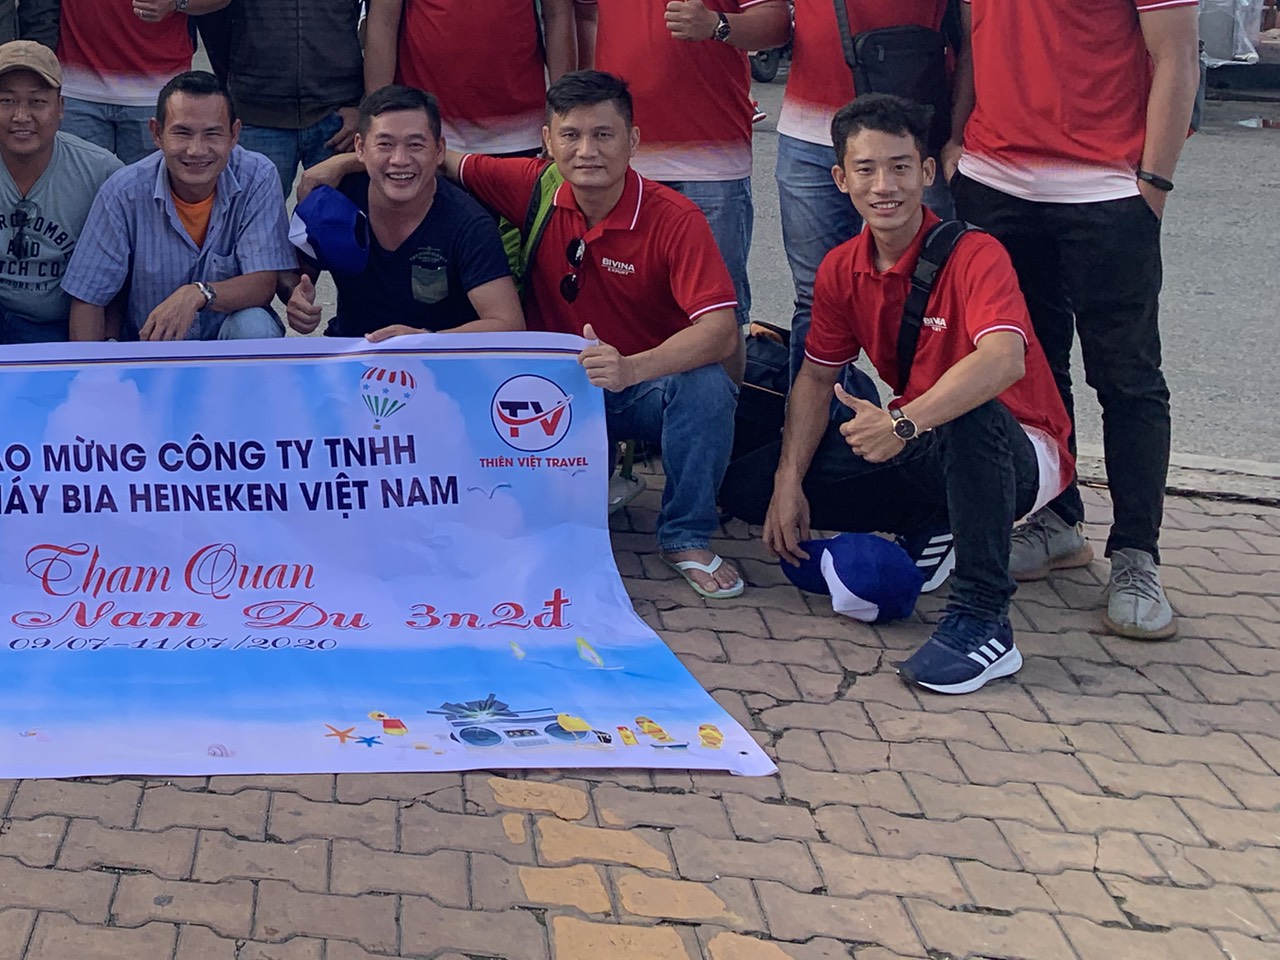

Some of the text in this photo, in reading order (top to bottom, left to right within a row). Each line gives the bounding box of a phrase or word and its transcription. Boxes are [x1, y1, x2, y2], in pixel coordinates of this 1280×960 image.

[7, 239, 40, 257] AND
[602, 257, 635, 271] BIVINA
[43, 435, 147, 472] MỪNG
[158, 433, 266, 472] CÔNG
[276, 439, 314, 469] TY
[324, 434, 416, 466] TNHH
[480, 454, 588, 470] THIÊN VIỆT TRAVEL
[63, 483, 119, 514] BIA
[130, 482, 288, 513] HEINEKEN
[299, 472, 369, 519] VIỆT
[382, 475, 459, 506] NAM
[26, 543, 315, 599] Tham Quan
[10, 600, 208, 630] Nam
[243, 600, 371, 630] Du
[405, 588, 572, 631] 3n2đ
